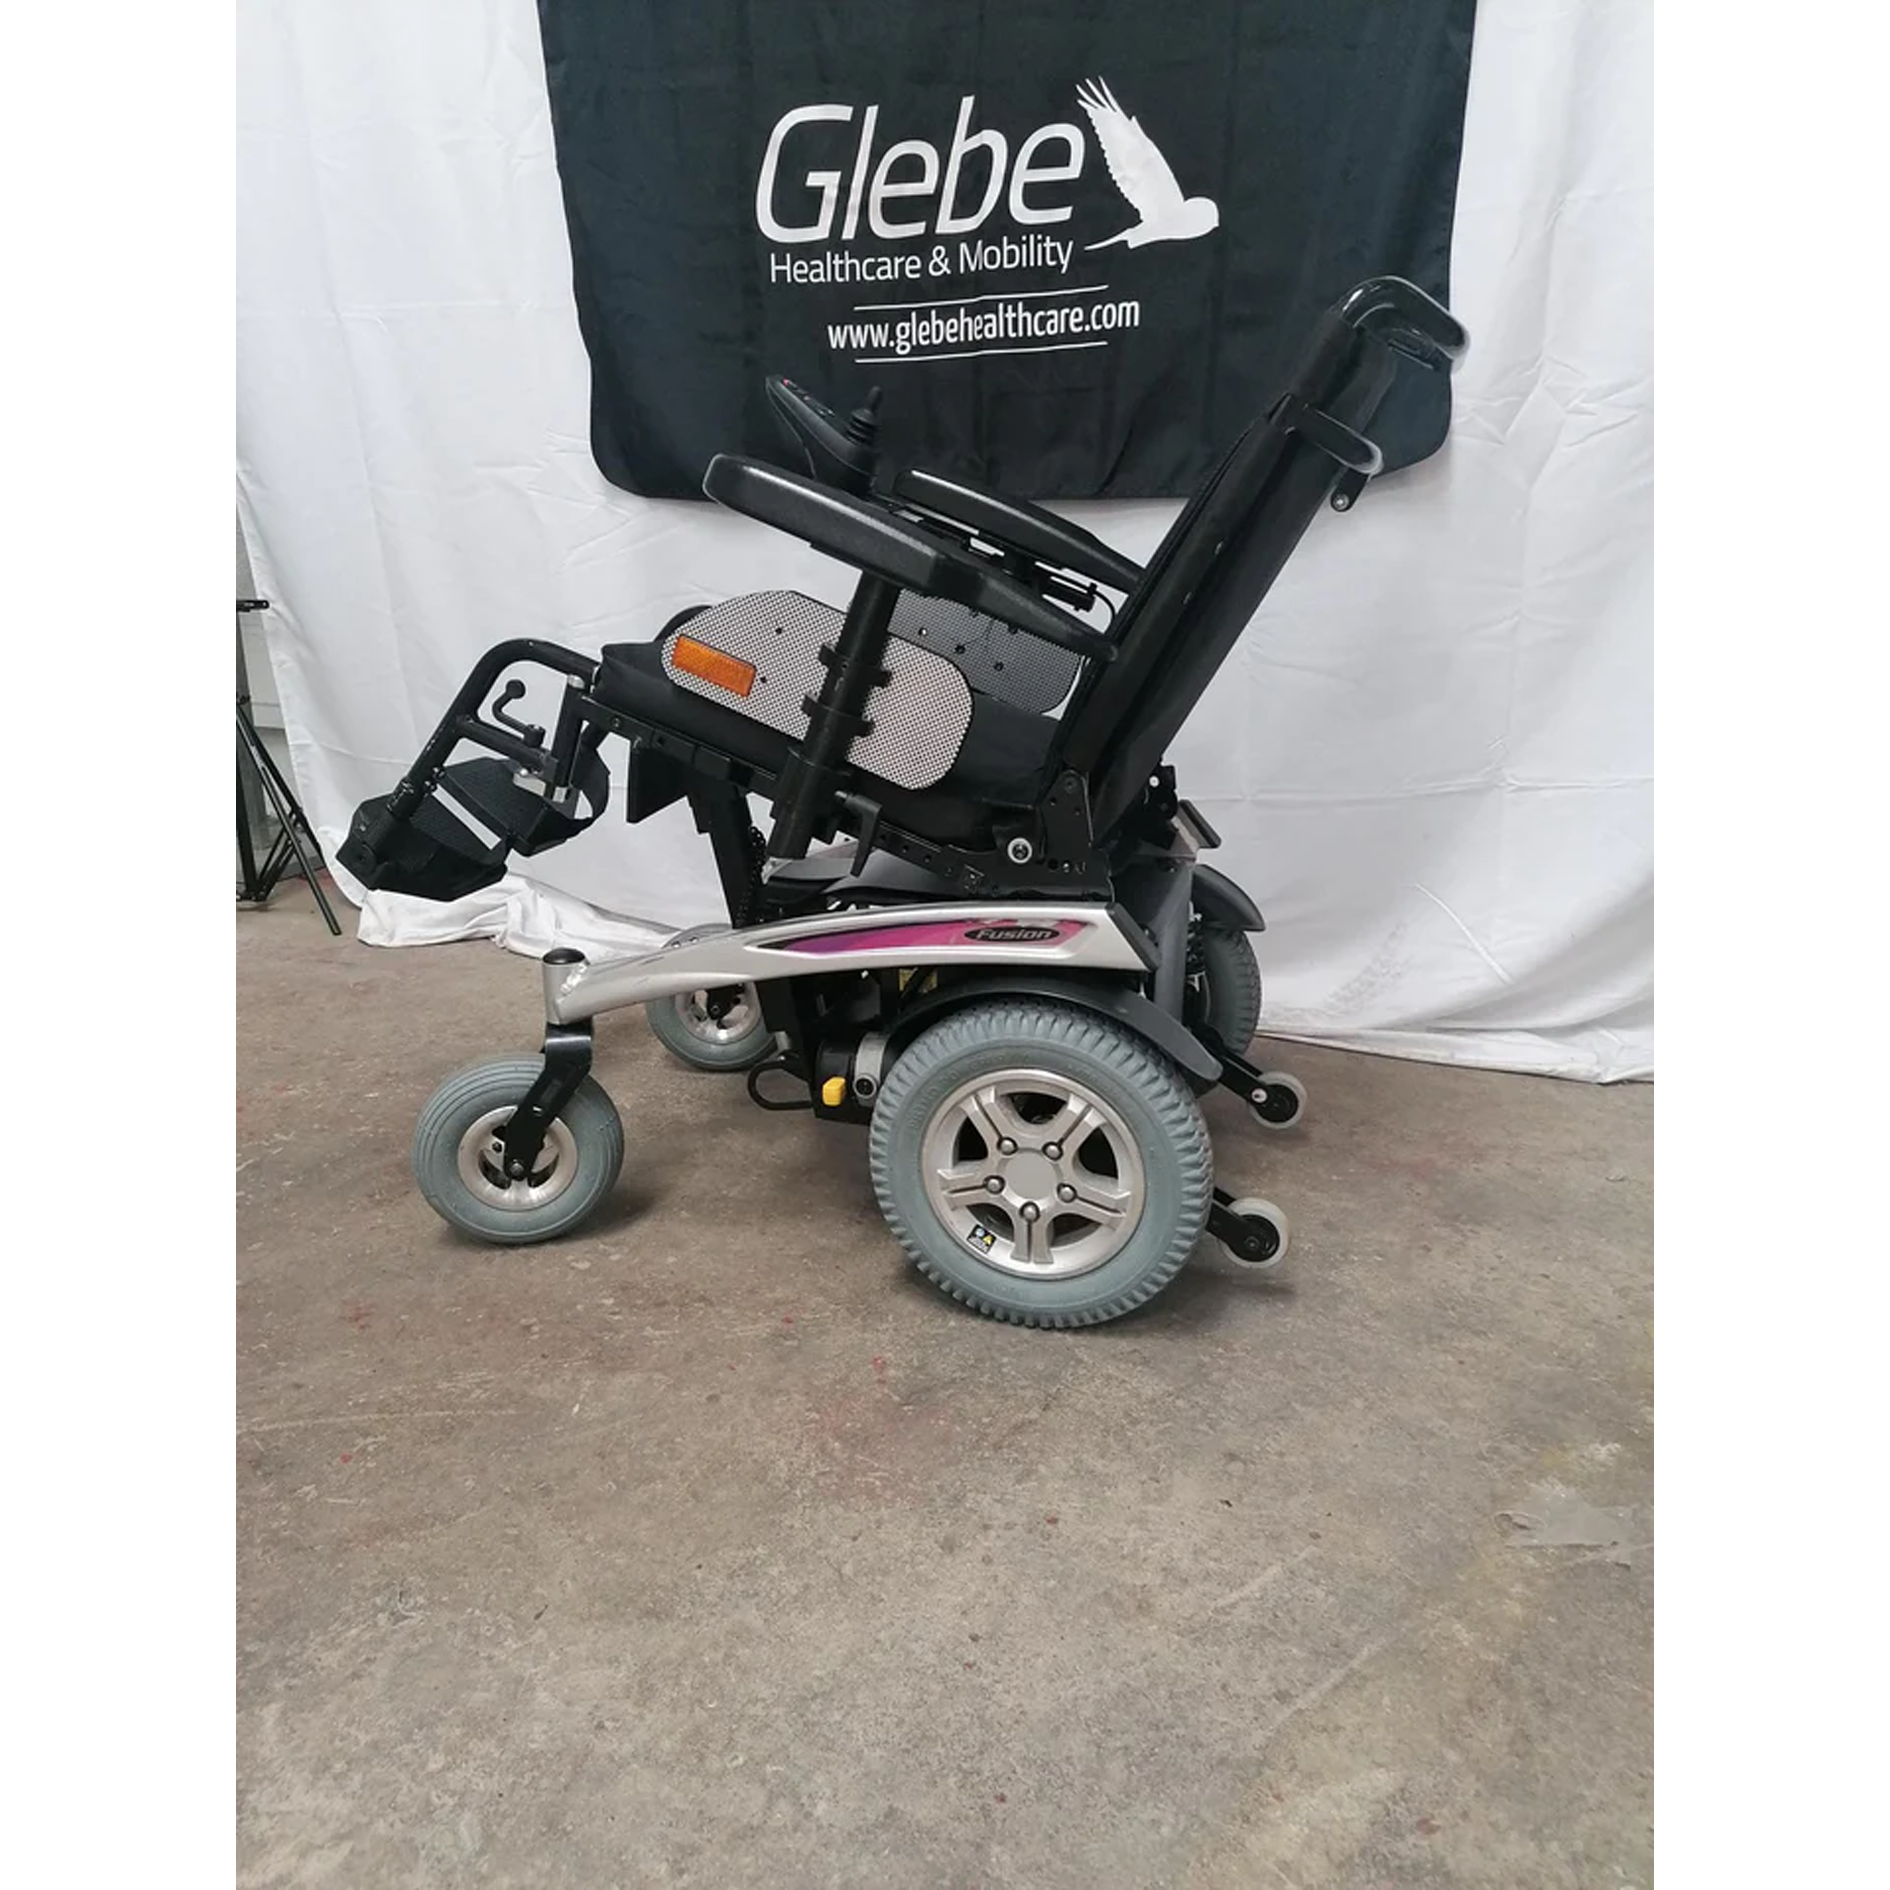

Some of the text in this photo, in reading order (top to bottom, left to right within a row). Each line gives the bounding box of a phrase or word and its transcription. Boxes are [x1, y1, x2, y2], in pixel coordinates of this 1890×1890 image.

[756, 96, 1085, 243] Glebe
[770, 234, 1074, 283] Healthcare & Mobility
[827, 300, 1140, 356] www.glebehealthcare.com
[976, 928, 1052, 940] Fusion
